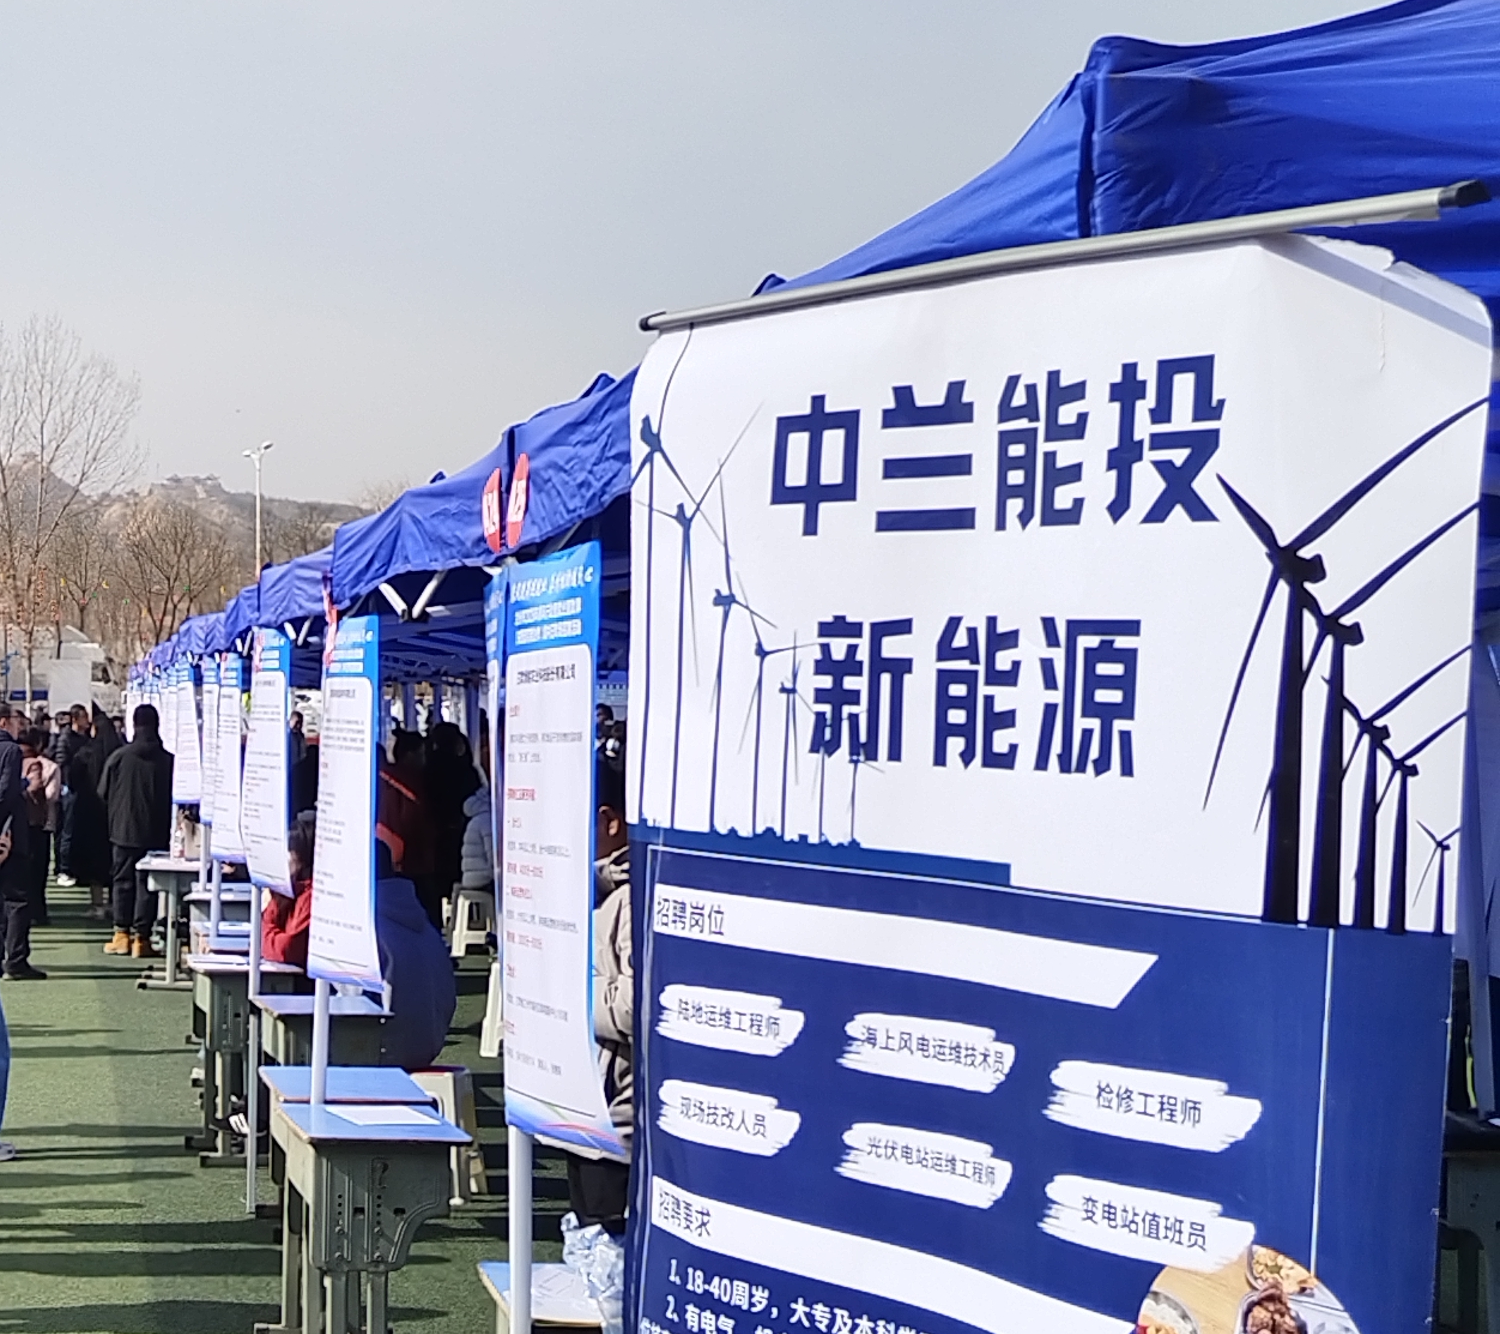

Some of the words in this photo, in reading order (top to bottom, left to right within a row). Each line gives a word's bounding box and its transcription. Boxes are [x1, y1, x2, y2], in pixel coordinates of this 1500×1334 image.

[768, 352, 1227, 538] 中兰能投
[808, 614, 1142, 779] 新能源
[656, 895, 725, 936] 招聘岗位
[676, 998, 781, 1041] 陆地运维工程师
[859, 1024, 1007, 1077] 海上风电运维技术员
[679, 1096, 768, 1138] 现场技改人员
[1094, 1079, 1202, 1129] 检修工程师
[866, 1136, 997, 1189] 光伏电站运维工程师
[658, 1188, 712, 1238] 招聘要求
[1080, 1195, 1208, 1253] 变电站值班员
